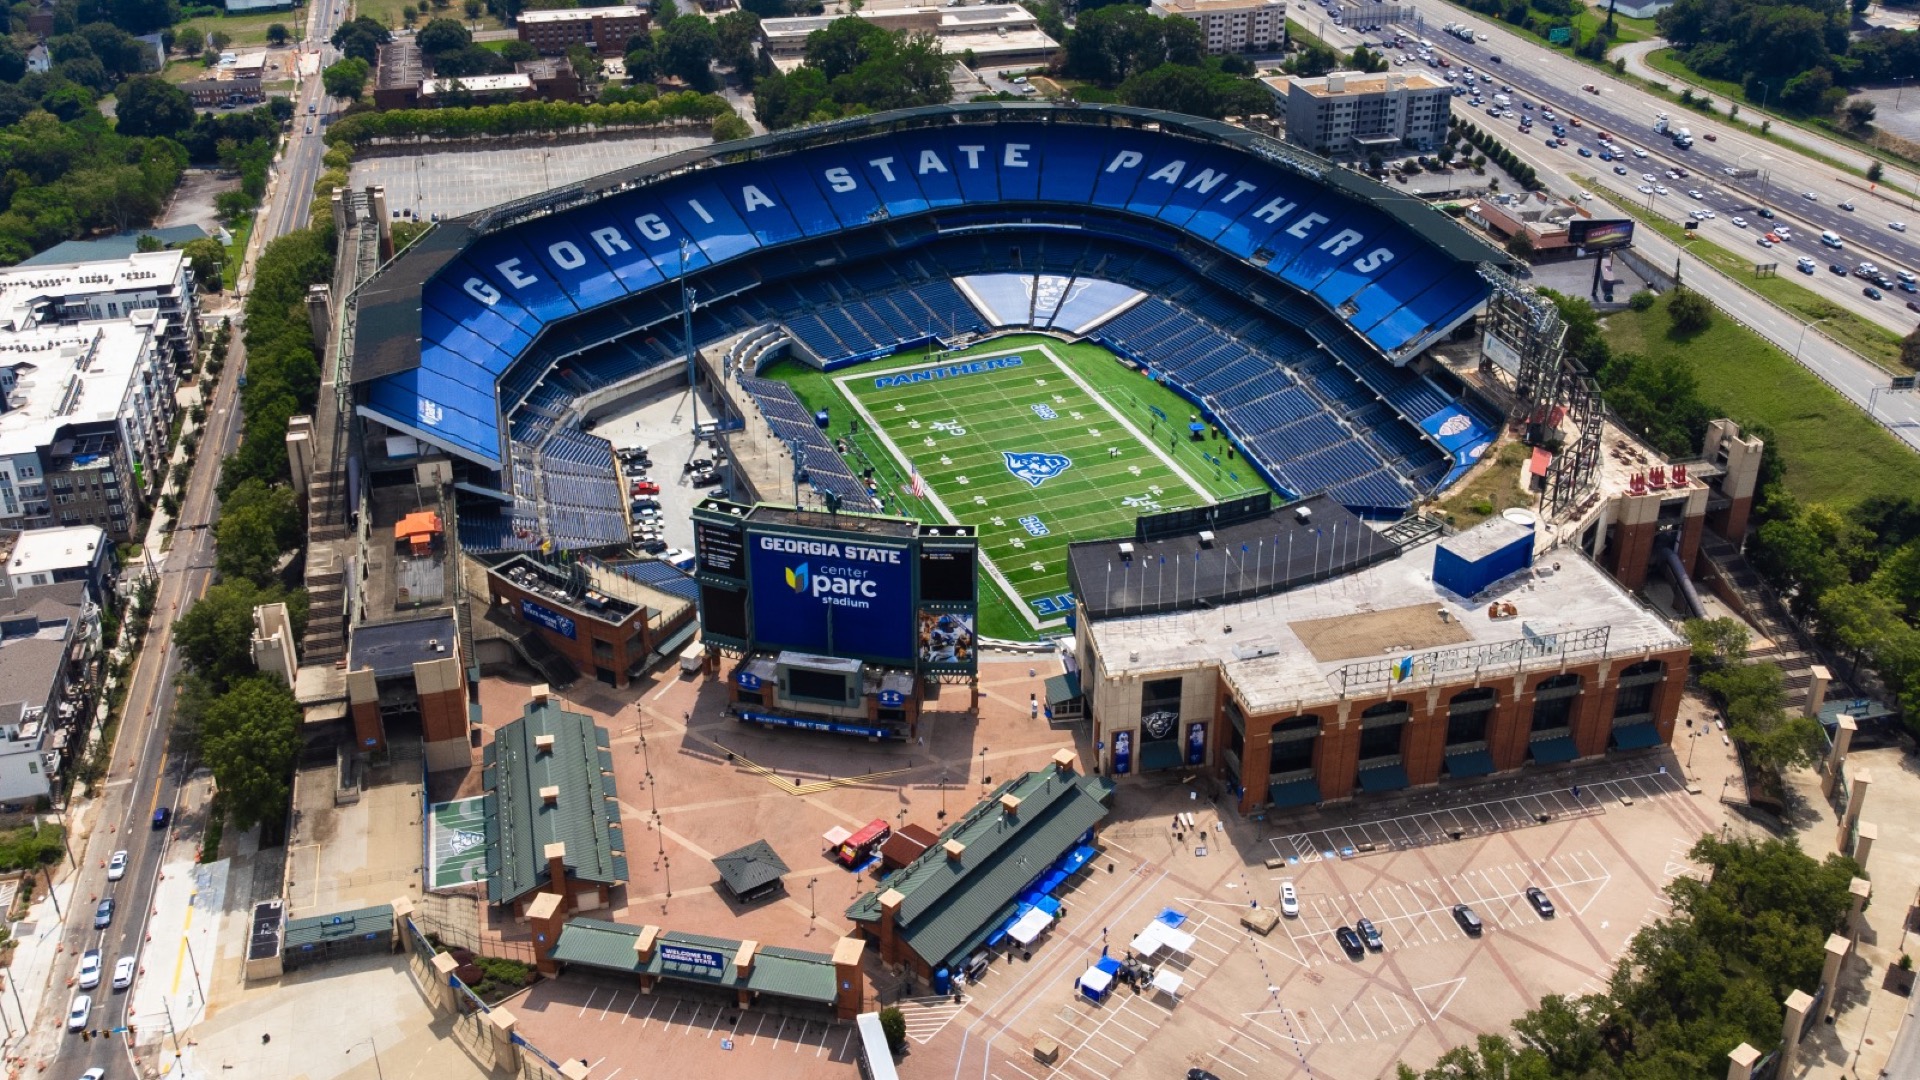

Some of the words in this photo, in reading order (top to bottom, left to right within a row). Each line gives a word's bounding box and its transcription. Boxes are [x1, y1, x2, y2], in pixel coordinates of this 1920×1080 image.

[463, 185, 775, 306] GEORGIA
[825, 143, 1030, 192] STATE
[1106, 150, 1395, 273] PANTHERS
[875, 356, 1023, 388] PANTHERS
[760, 536, 841, 558] GEORGIA
[844, 546, 901, 564] STATE
[820, 564, 869, 579] center
[812, 573, 877, 598] parc
[822, 595, 870, 609] stadium
[662, 953, 694, 962] GEORGIA
[694, 958, 717, 966] STATE
[665, 948, 702, 959] WELCOME
